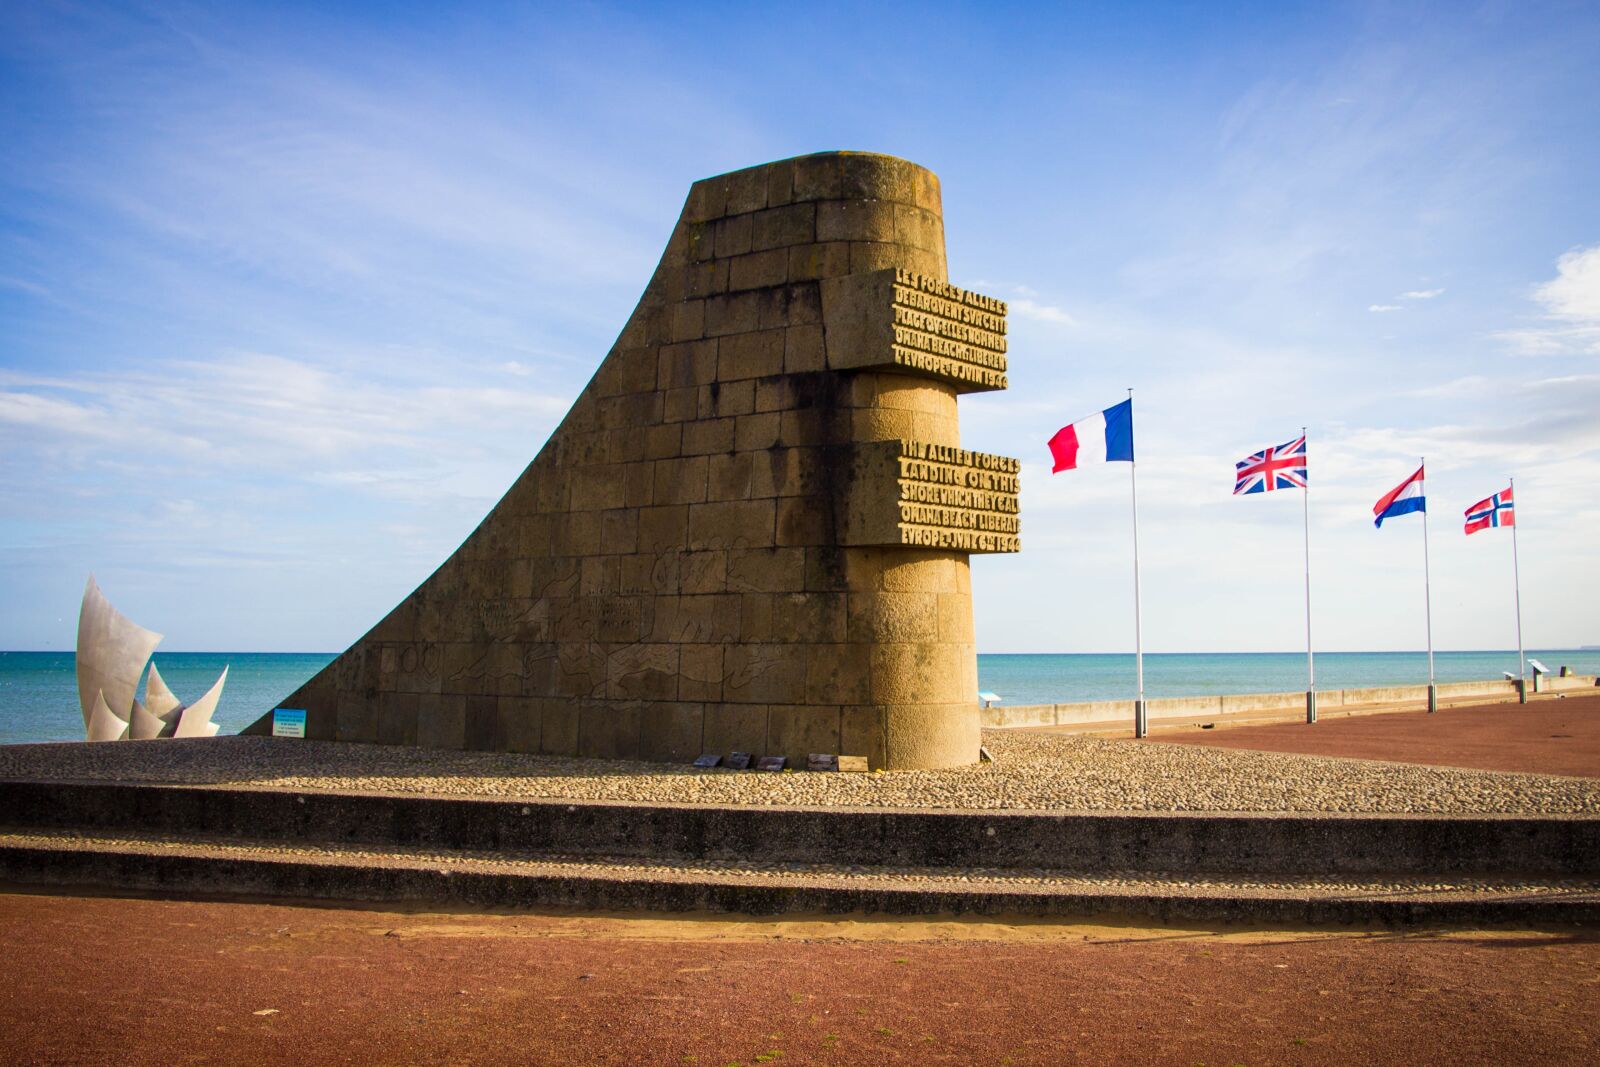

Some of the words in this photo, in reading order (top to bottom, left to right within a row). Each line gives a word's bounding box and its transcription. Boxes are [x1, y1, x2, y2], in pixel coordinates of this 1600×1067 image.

[921, 275, 964, 302] FORCES
[896, 307, 925, 329] PLAGE
[968, 328, 1008, 352] NOMMENT
[983, 313, 1008, 334] CETTE
[896, 328, 930, 350] OMAHA
[931, 336, 962, 359] BEACH
[959, 363, 982, 383] JVIN
[984, 368, 1008, 389] 1944
[927, 443, 972, 467] ALLIED
[975, 452, 1021, 473] FORCES
[901, 460, 965, 487] LANDING
[968, 470, 990, 490] ON
[990, 474, 1021, 494] THIS
[901, 482, 939, 503] SHORE
[940, 487, 972, 508] WHICH
[973, 491, 996, 511] THEY
[997, 495, 1021, 513] CALL
[901, 504, 941, 525] OMAHA
[942, 508, 976, 529] BEACH
[979, 514, 1021, 534] LIBERATE
[996, 535, 1021, 553] 1944
